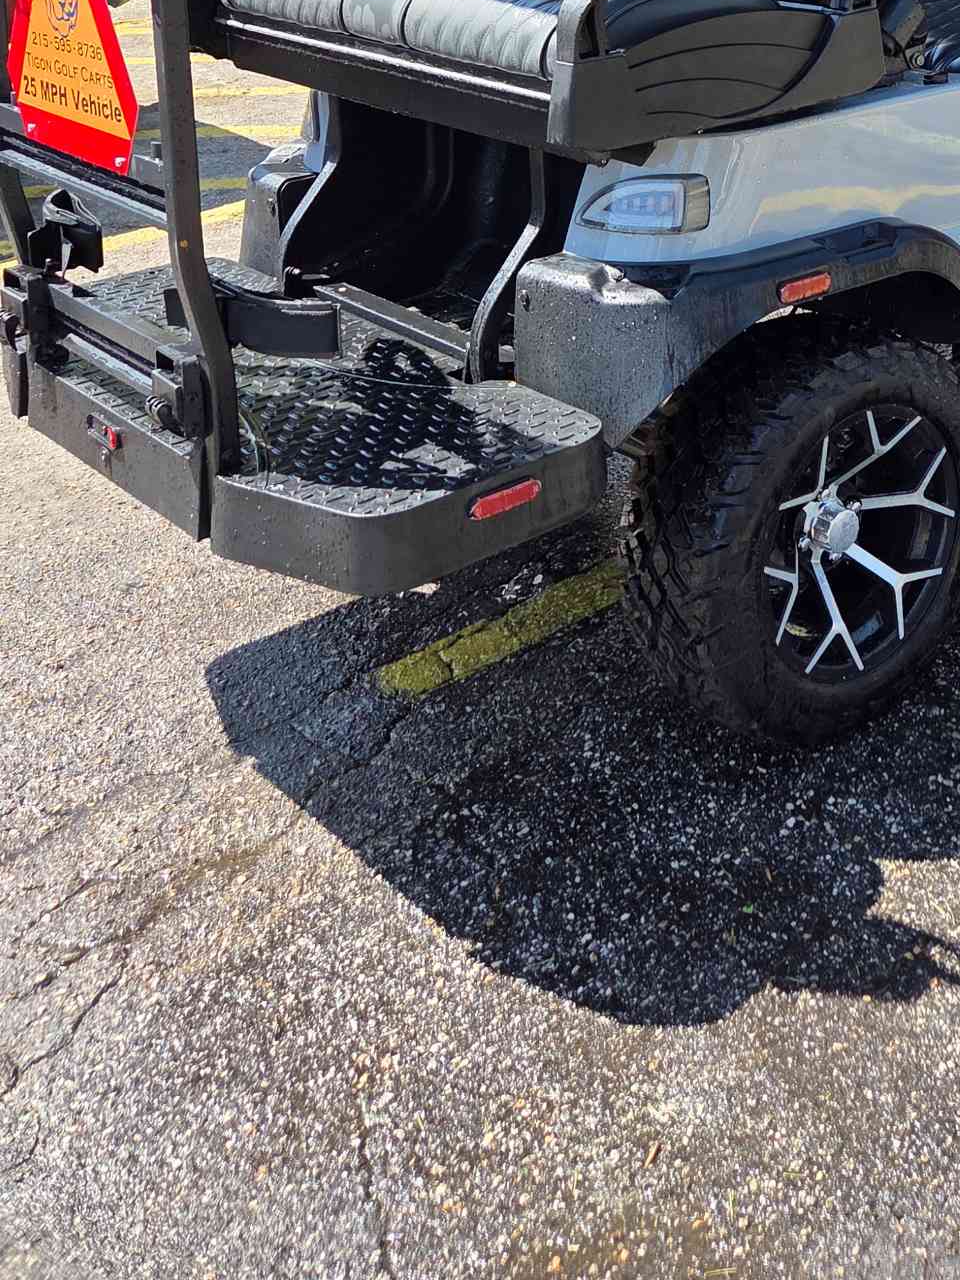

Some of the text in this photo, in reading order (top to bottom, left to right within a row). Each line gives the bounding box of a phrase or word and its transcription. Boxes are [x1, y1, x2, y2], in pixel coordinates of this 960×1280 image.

[32, 31, 103, 62] 215-595-8736
[26, 51, 113, 89] TIGON GOLF CARTS
[23, 75, 122, 122] 25 MPH Vehicle
